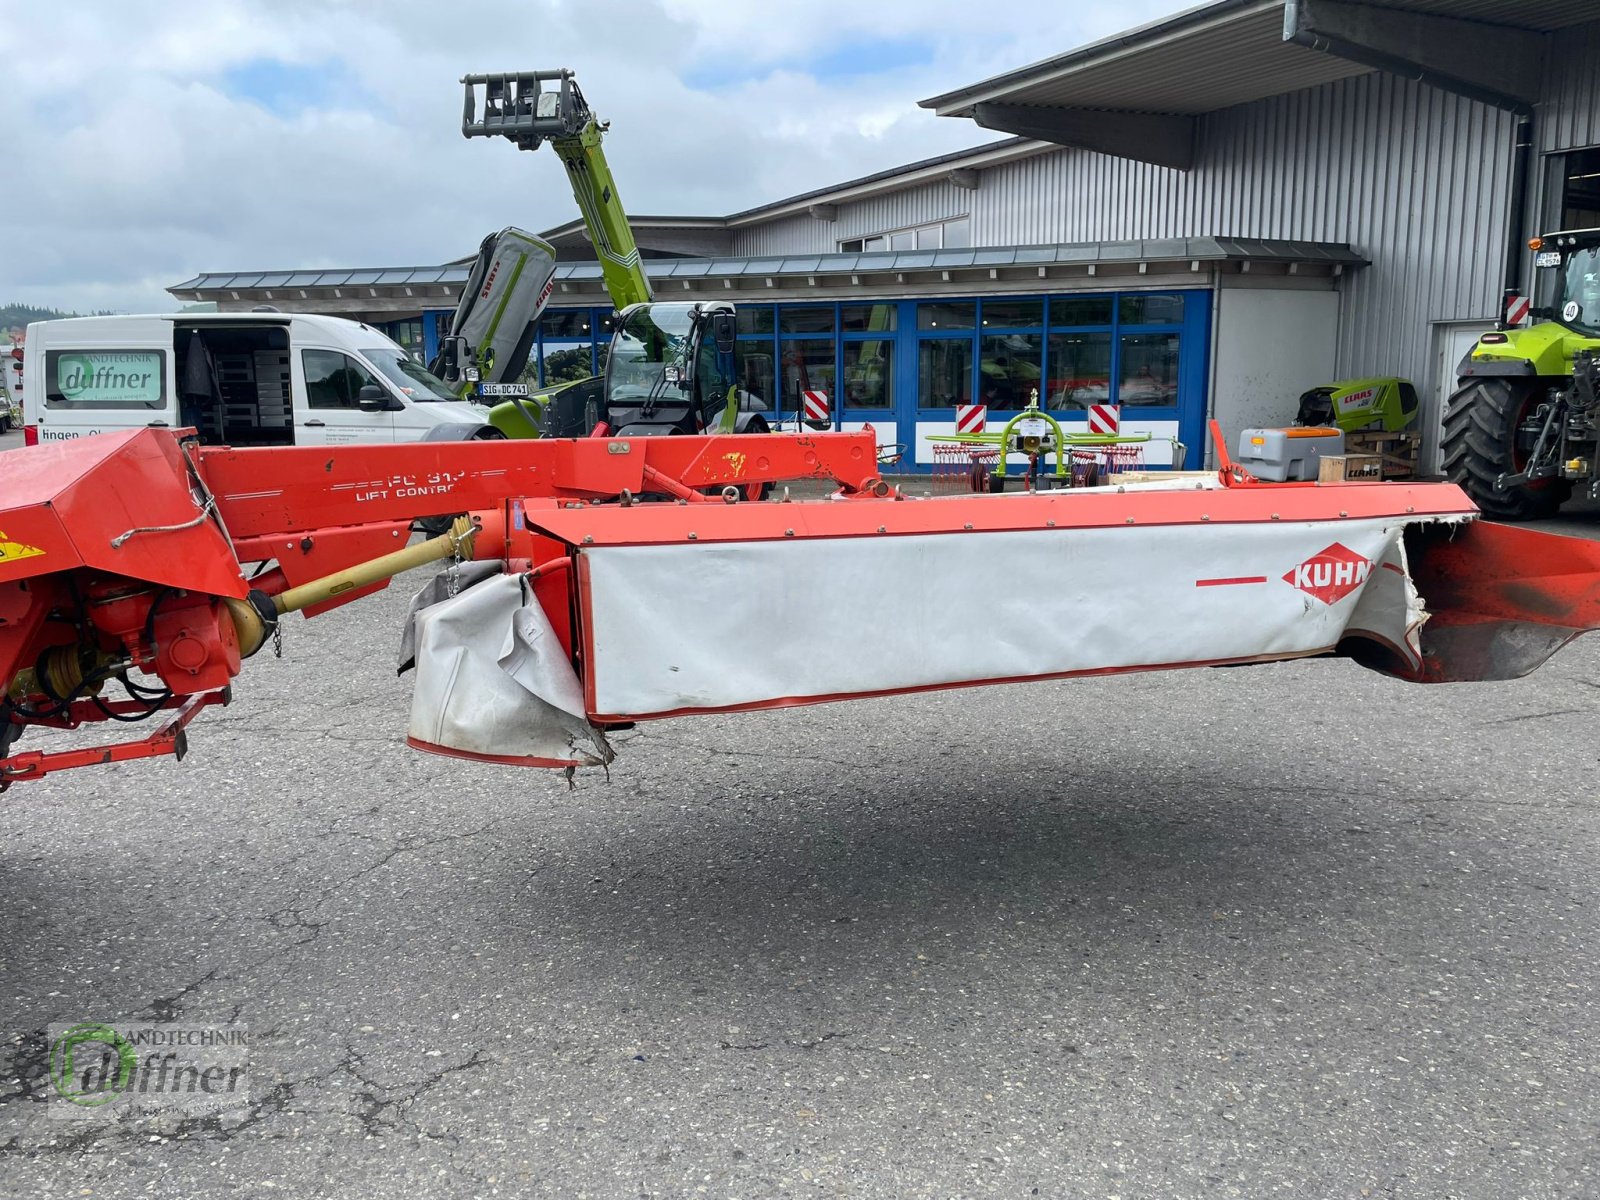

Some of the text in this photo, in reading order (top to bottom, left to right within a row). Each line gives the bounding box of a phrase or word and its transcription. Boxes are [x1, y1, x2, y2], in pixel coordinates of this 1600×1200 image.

[535, 276, 555, 309] CLAA
[1565, 305, 1575, 317] 40
[81, 354, 151, 363] LANDTECHNIK
[65, 366, 151, 389] duffner
[483, 384, 527, 394] SIG DC 741
[1344, 389, 1373, 404] CLAAS
[1348, 469, 1379, 478] CLAAS
[356, 490, 388, 501] LIFT
[1294, 560, 1373, 589] KUHN
